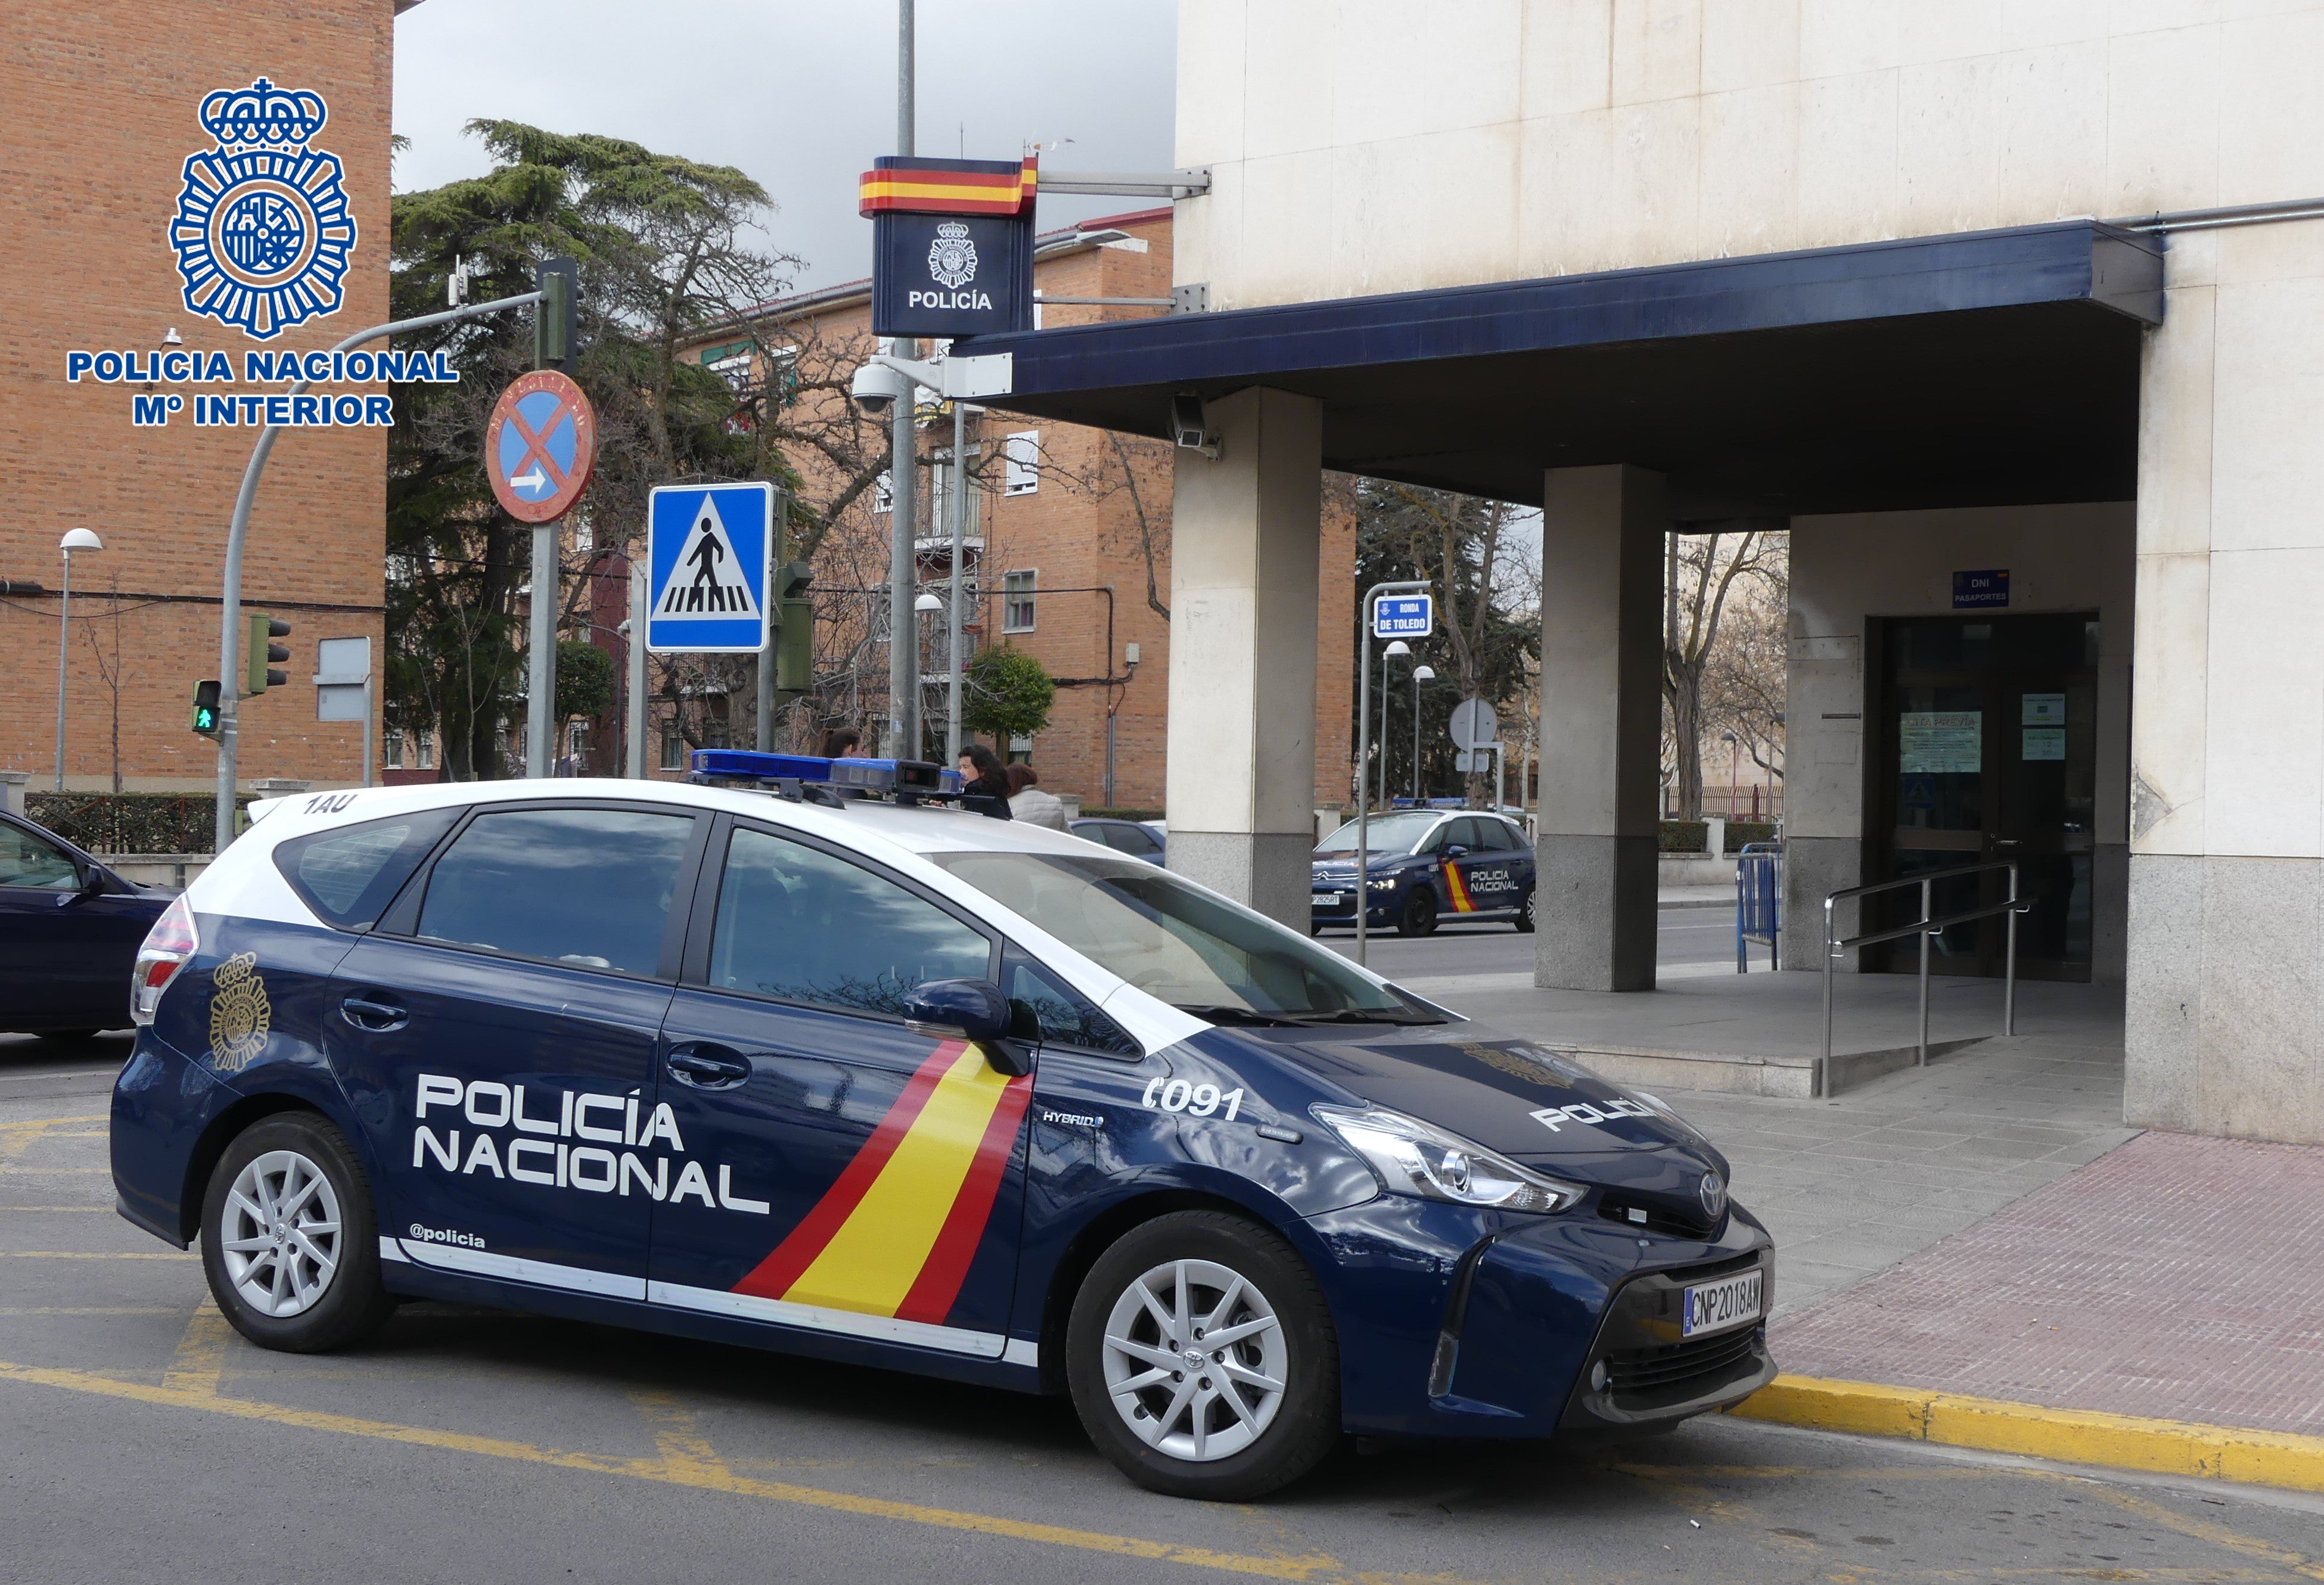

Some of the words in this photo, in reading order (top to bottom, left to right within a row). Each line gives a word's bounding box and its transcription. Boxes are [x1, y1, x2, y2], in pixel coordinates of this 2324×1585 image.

[909, 288, 992, 310] POLICÍA
[1971, 579, 1989, 588] DNI
[1400, 603, 1419, 613] RONDA
[1955, 593, 2007, 602] PASAPORTES
[1380, 620, 1391, 630] DE
[1393, 618, 1425, 630] TOLEDO
[303, 794, 359, 815] 1AU
[1471, 881, 1518, 892] NACIONAL
[1160, 1079, 1244, 1121] 091
[416, 1073, 684, 1152] POLICÍA
[1043, 1111, 1094, 1126] HYBRID
[413, 1126, 770, 1215] NACIONAL
[409, 1223, 486, 1249] @policia
[1691, 1276, 1761, 1328] CNP2018AW
